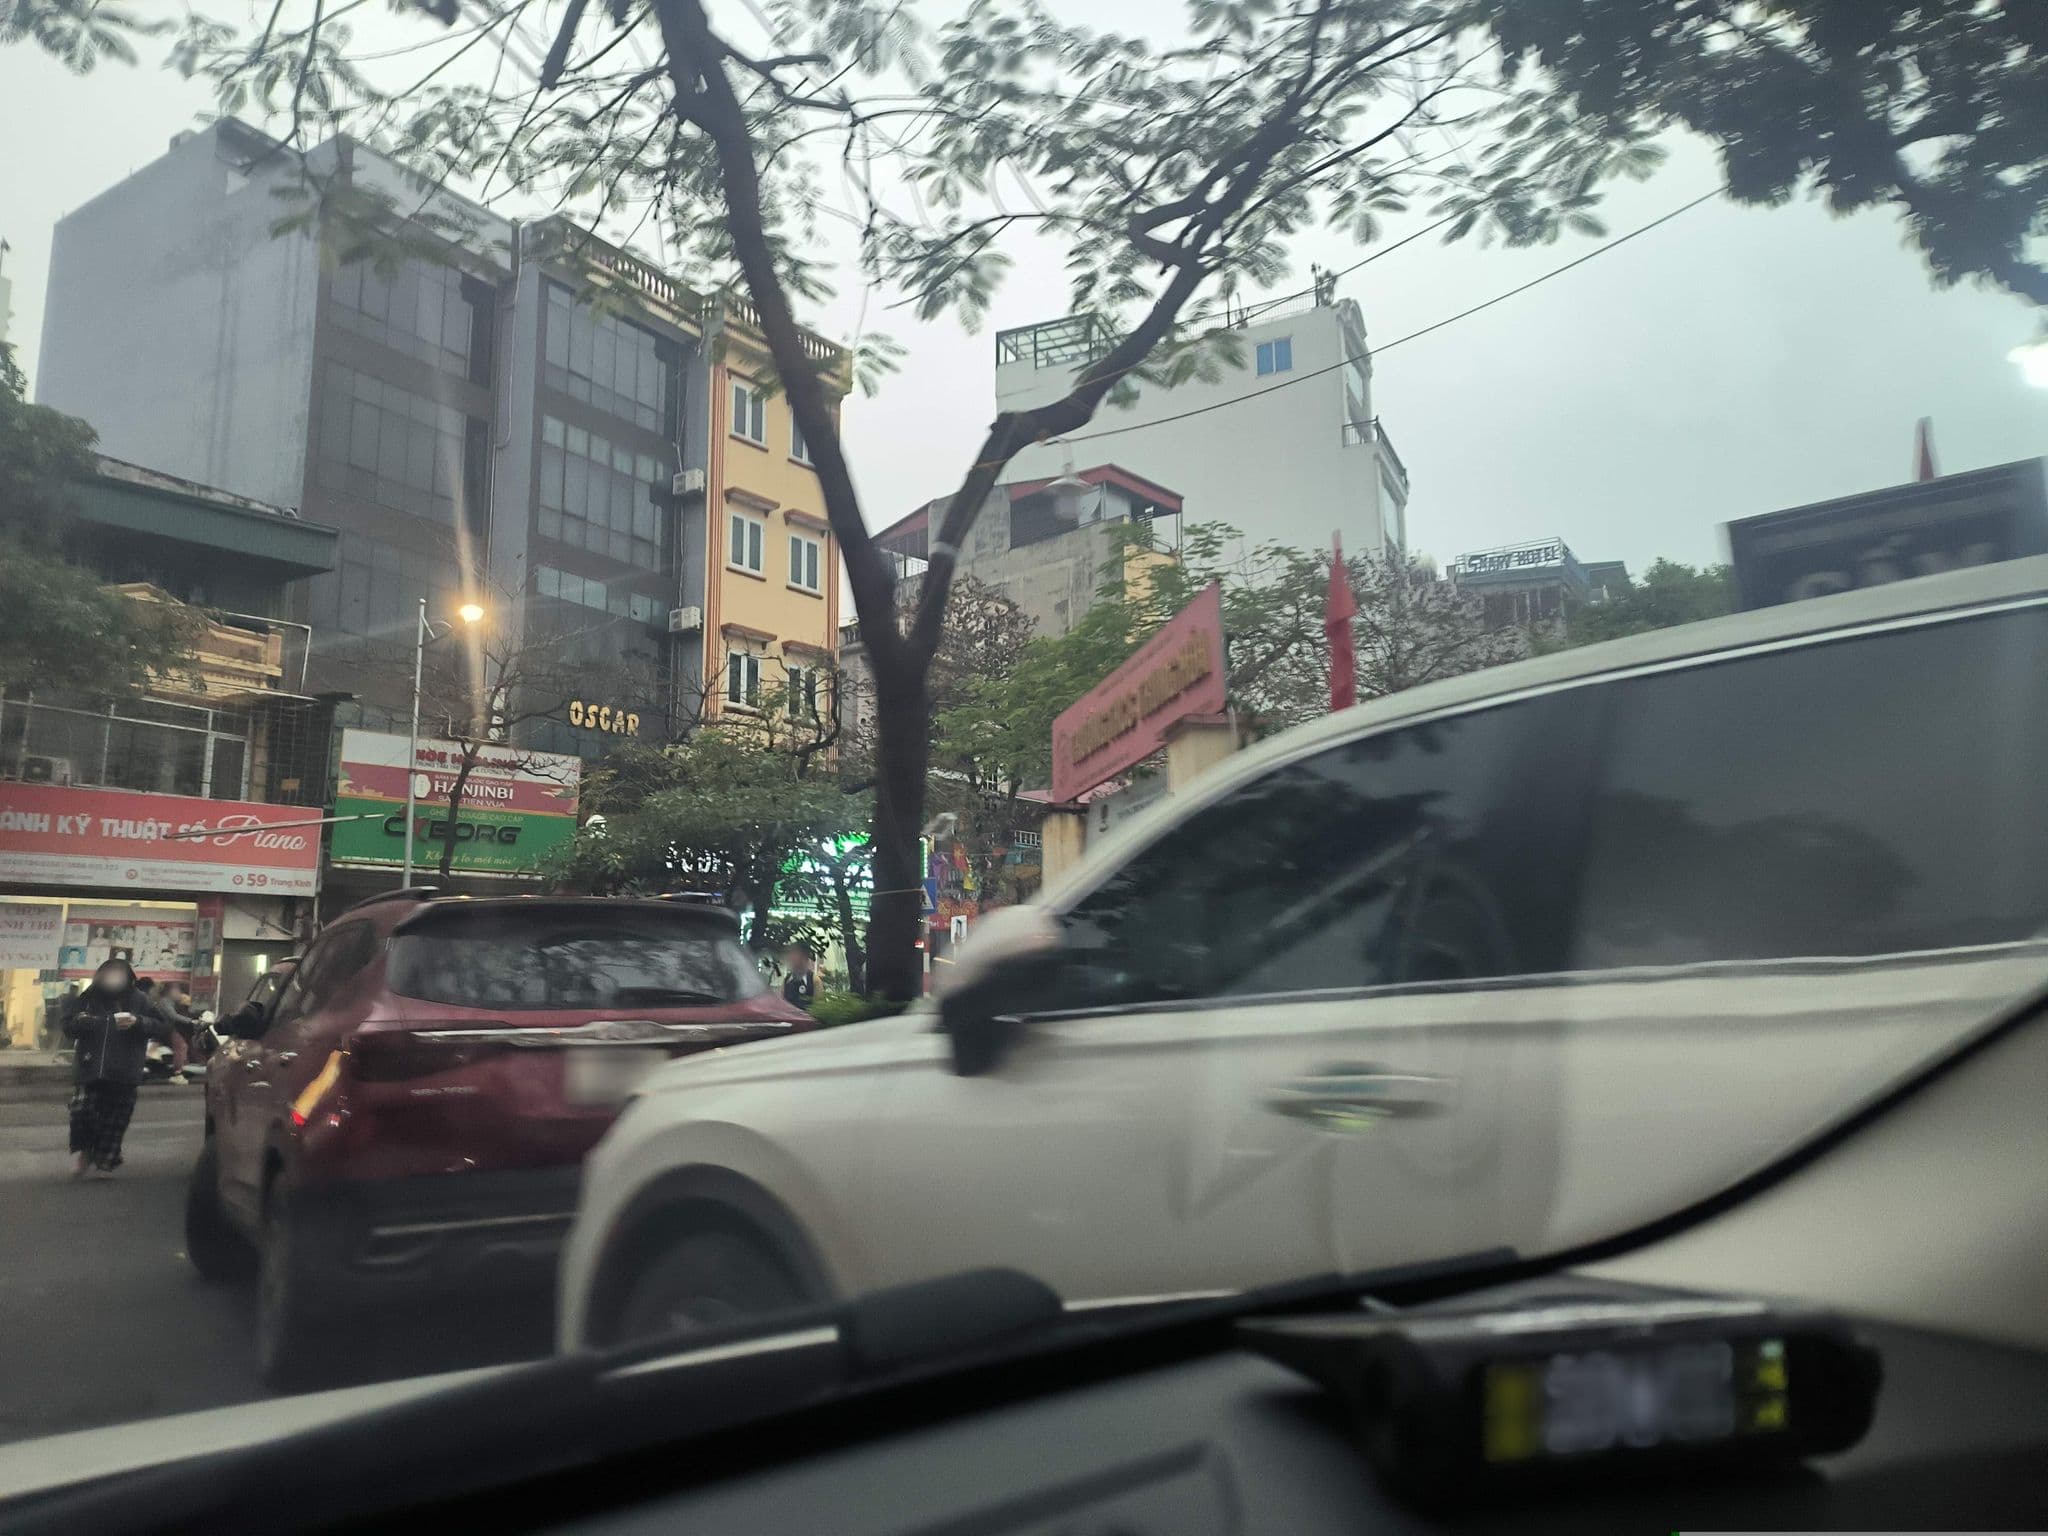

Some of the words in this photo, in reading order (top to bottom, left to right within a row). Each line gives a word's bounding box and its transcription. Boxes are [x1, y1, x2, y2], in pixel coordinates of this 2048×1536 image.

[569, 700, 640, 736] OSCAR
[56, 812, 91, 837] KỸ
[100, 818, 172, 843] THUẬT
[175, 819, 207, 844] SỐ
[213, 815, 307, 850] Piano
[246, 873, 268, 887] 59
